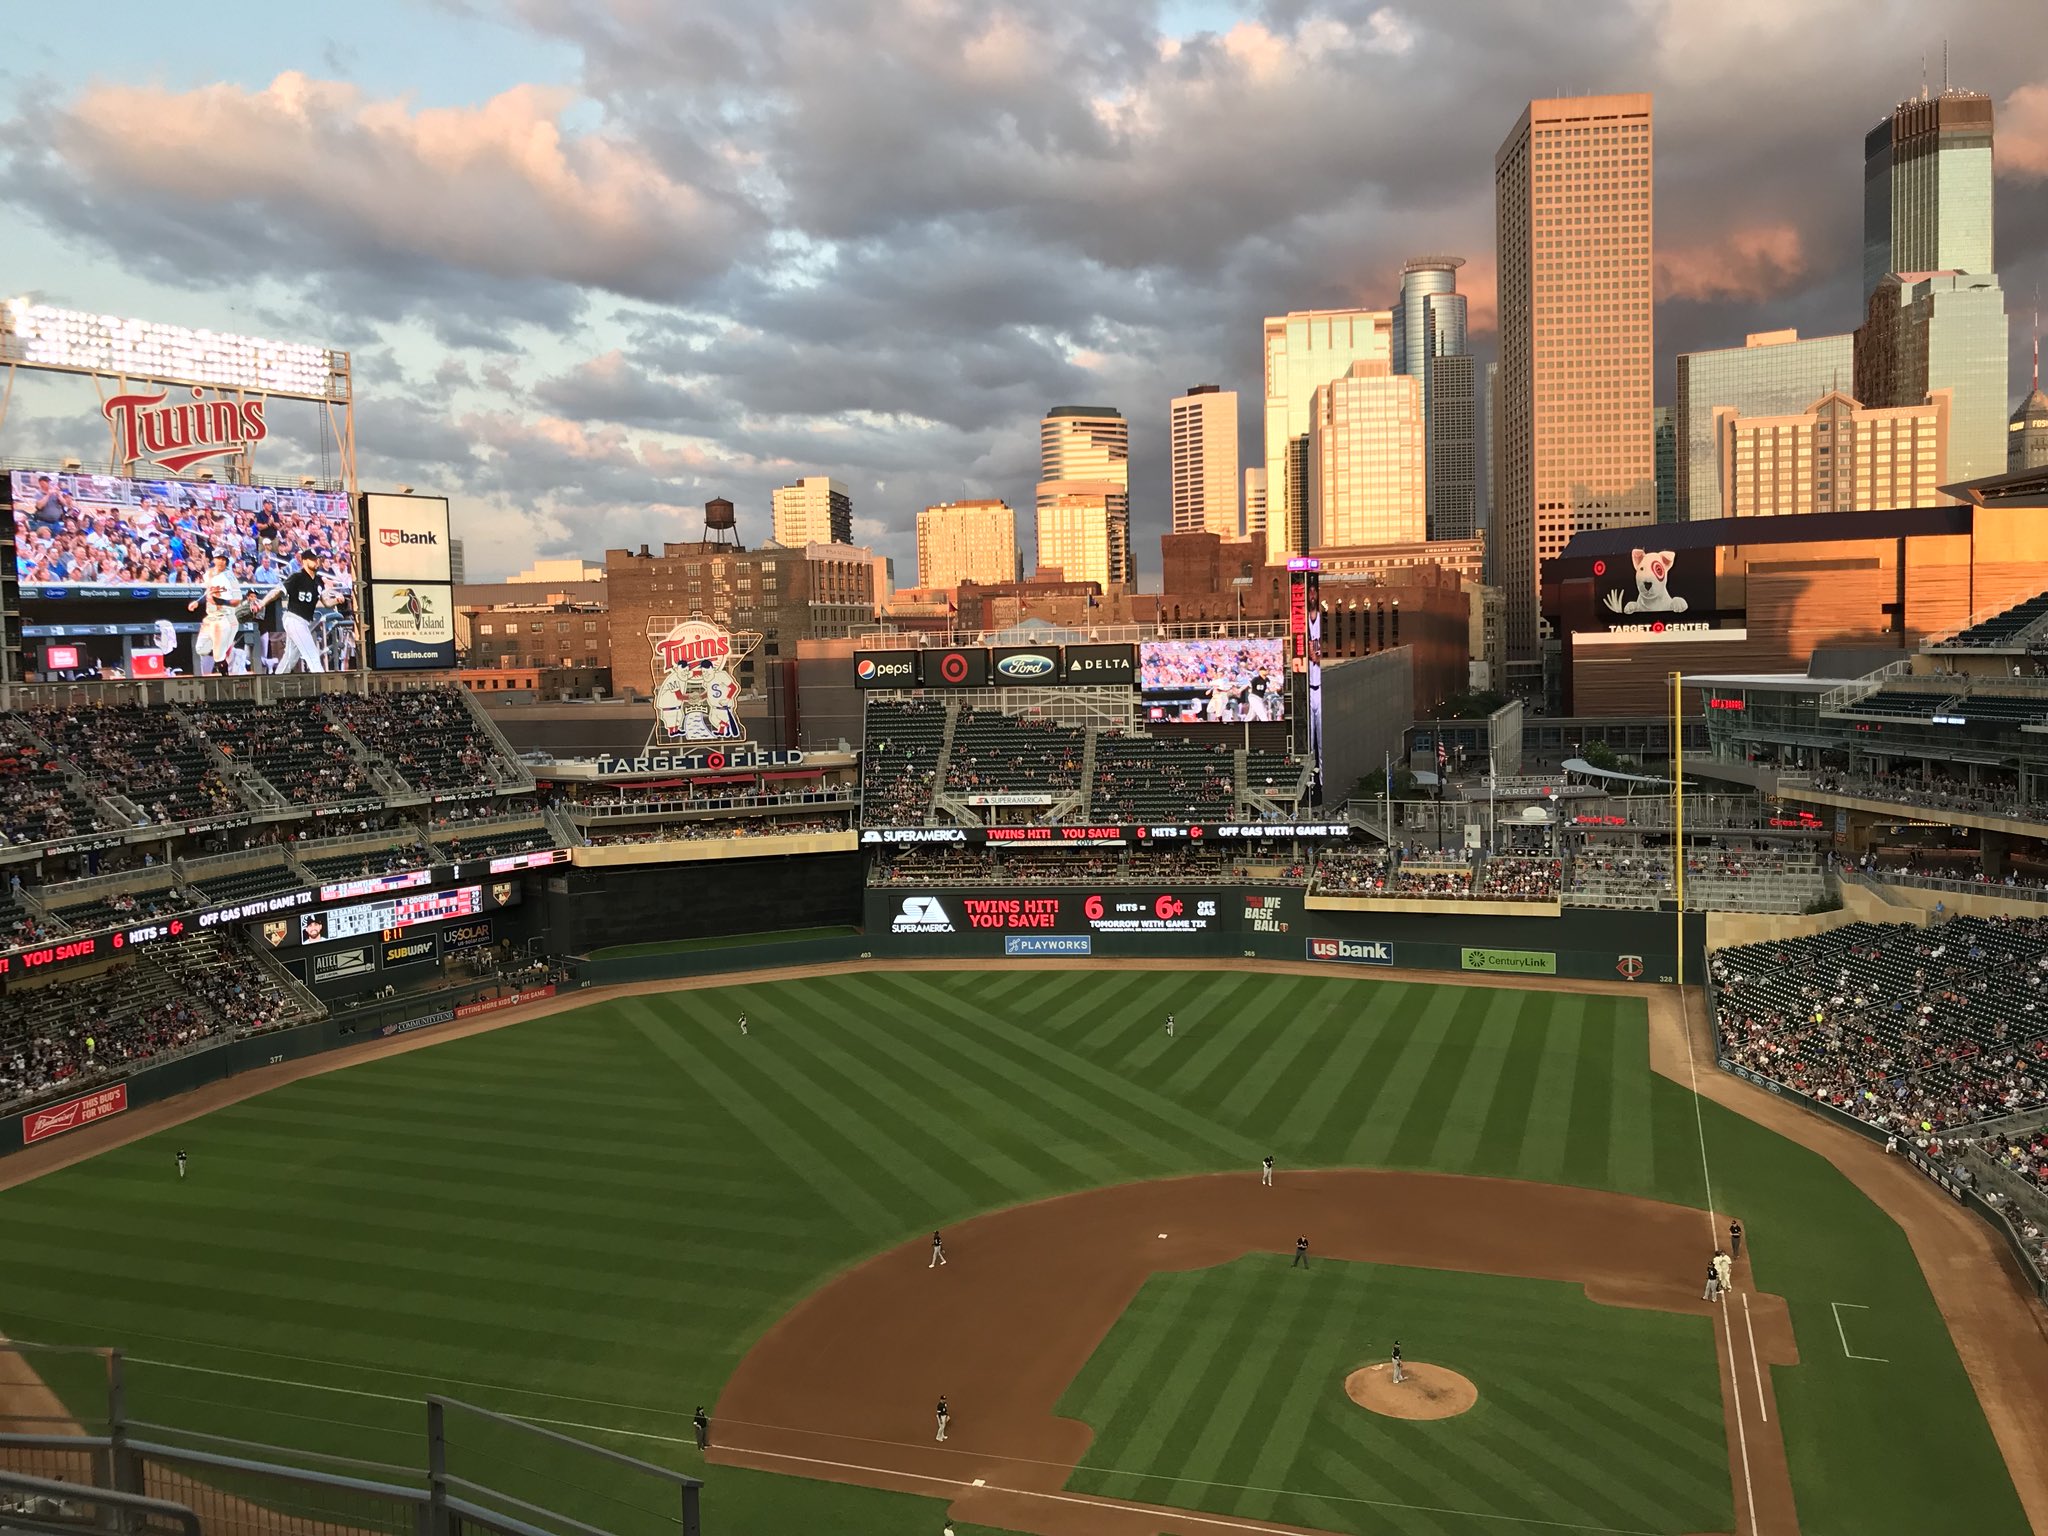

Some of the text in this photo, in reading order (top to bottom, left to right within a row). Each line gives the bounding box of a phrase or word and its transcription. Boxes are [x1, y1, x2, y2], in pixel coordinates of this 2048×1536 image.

[103, 386, 268, 465] Twins
[380, 529, 437, 546] usbank
[298, 592, 312, 602] 53
[1292, 583, 1306, 633] DOZIER
[382, 616, 444, 630] Treasure Island
[1608, 623, 1710, 633] TARGET CENTER
[656, 635, 730, 670] Twins
[877, 661, 912, 676] pepsi
[1008, 659, 1042, 674] Ford
[1085, 658, 1130, 670] DELTA
[600, 750, 804, 773] TARGET FIELD
[1770, 818, 1824, 828] Great Clips
[884, 830, 967, 842] SUPERAMERICA
[987, 830, 1026, 840] TWINS
[1027, 829, 1051, 839] HIT!
[1062, 829, 1086, 839] YOU
[1088, 828, 1120, 838] SAVE!
[1136, 826, 1146, 838] 6
[1152, 826, 1176, 838] HITS
[1218, 826, 1239, 837] OFF
[1241, 826, 1266, 836] GAS
[1266, 826, 1295, 836] WITH
[1296, 825, 1328, 836] GAME
[1330, 825, 1348, 836] TIX
[964, 900, 1059, 914] TWINS HIT!
[1084, 895, 1104, 920] 6
[1116, 904, 1138, 912] HITS
[1155, 895, 1184, 920] 6¢
[1197, 901, 1215, 909] OFF
[1264, 896, 1282, 908] WE
[1196, 908, 1216, 916] GAS
[1244, 908, 1274, 920] BASE
[892, 922, 955, 933] SUPERAMERICA
[970, 914, 1054, 928] YOU SAVE!
[1090, 920, 1206, 928] TOMORROW WITH GAME TIX
[1254, 920, 1280, 932] BALL
[22, 949, 53, 967] YOU
[56, 940, 95, 960] SAVE!
[113, 933, 124, 948] 6
[129, 926, 157, 944] HITS
[199, 912, 220, 927] OFF
[221, 908, 241, 922] GAS
[242, 901, 268, 918] WITH
[269, 895, 295, 911] GAME
[296, 890, 312, 905] TIX
[383, 928, 402, 942] 0:11
[386, 942, 432, 962] SUBWAY
[1021, 941, 1088, 950] PLAYWORKS
[1313, 939, 1388, 959] usbank
[316, 954, 337, 969] ALTEC
[1488, 955, 1546, 968] CenturyLink
[457, 1004, 481, 1017] GETTING
[482, 1000, 498, 1012] MORE
[270, 1054, 283, 1064] 377
[82, 1090, 120, 1110] THIS BUD'S
[82, 1108, 96, 1120] FOR
[34, 1112, 75, 1131] Budweiser
